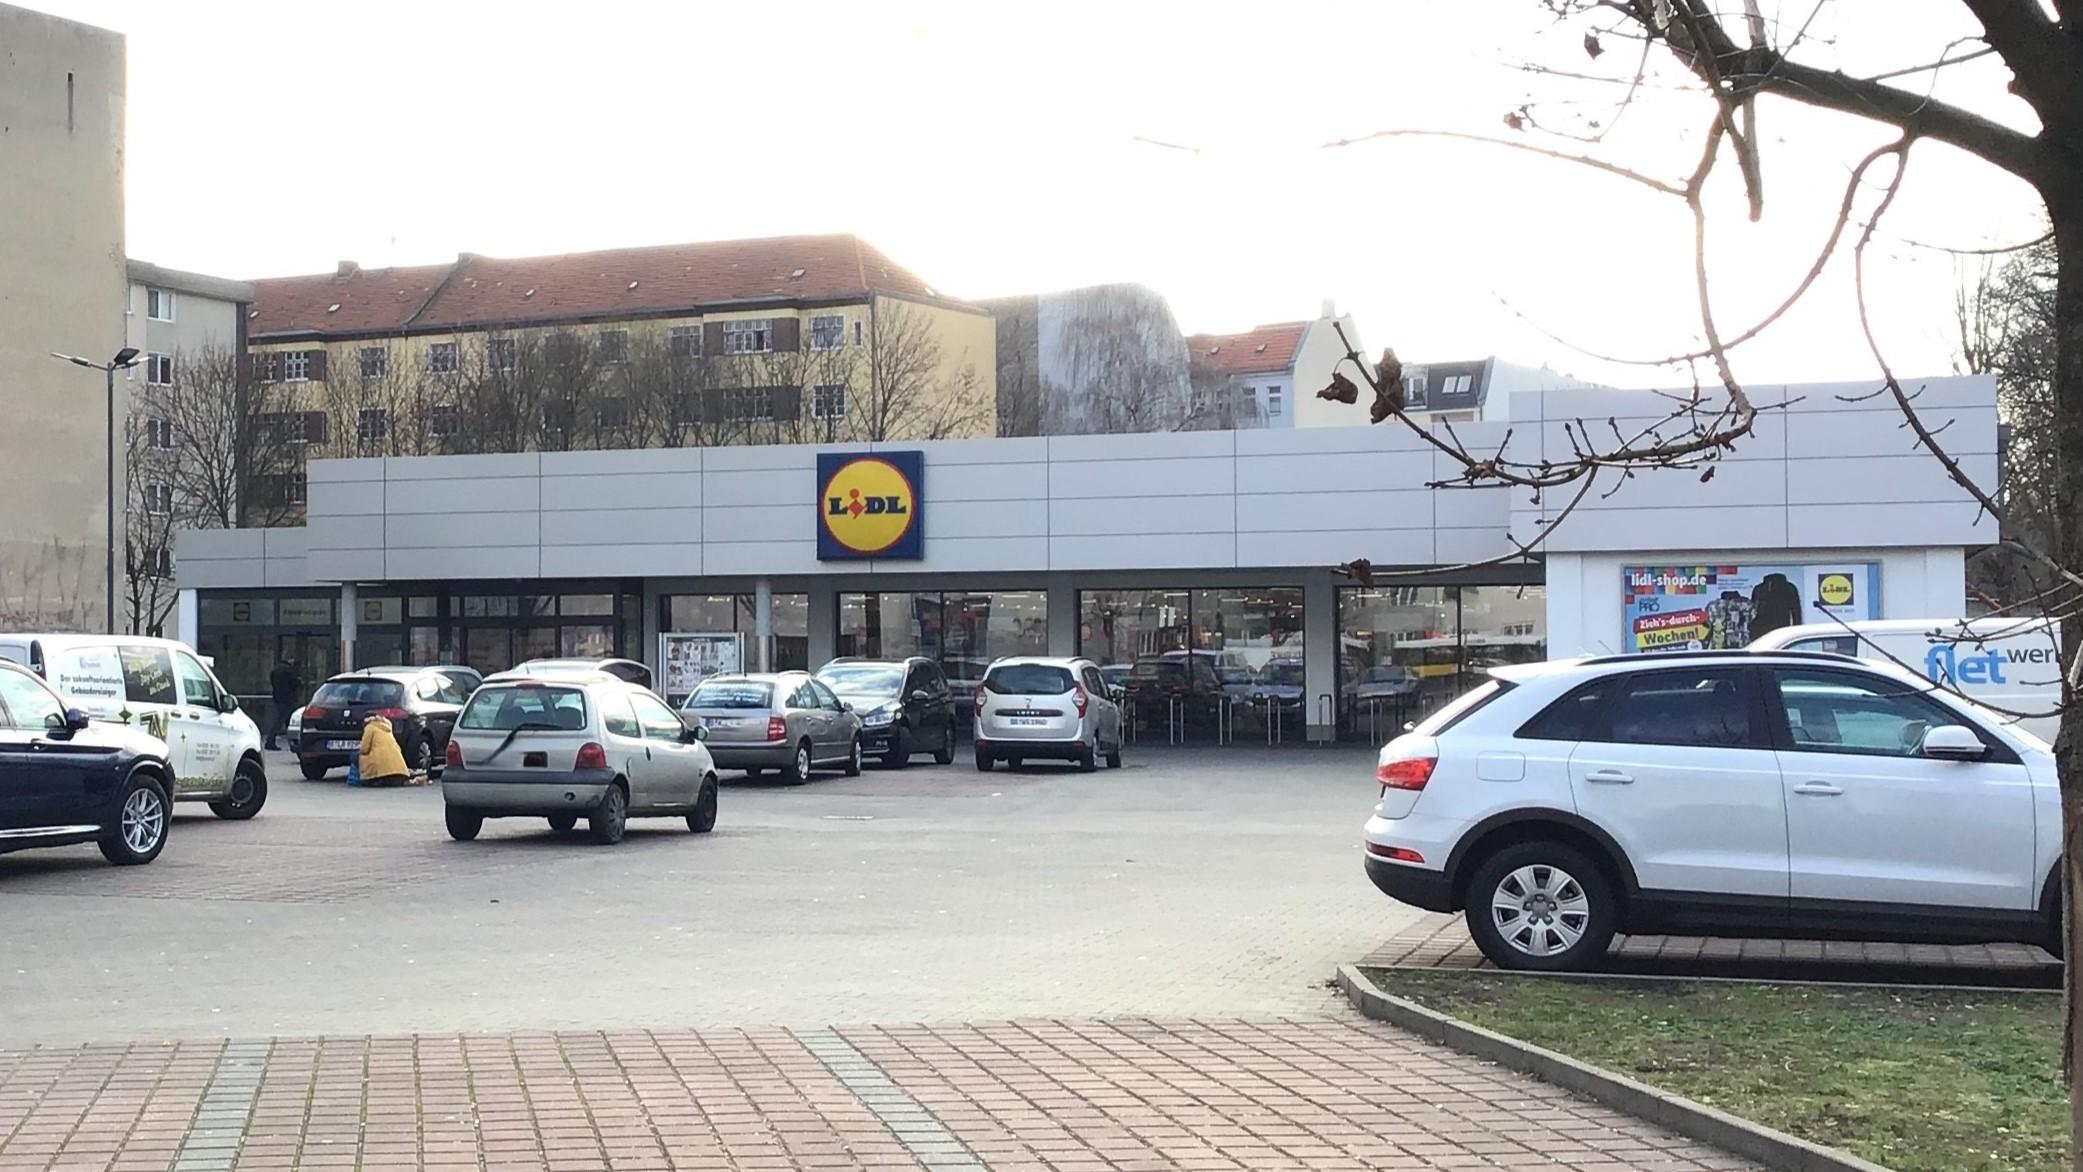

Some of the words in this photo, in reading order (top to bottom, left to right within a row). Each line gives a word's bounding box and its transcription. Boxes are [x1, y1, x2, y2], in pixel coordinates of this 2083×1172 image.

[1631, 573, 1707, 589] lidl-shop.de
[1643, 627, 1699, 645] Wochen!
[1924, 645, 2007, 684] flet
